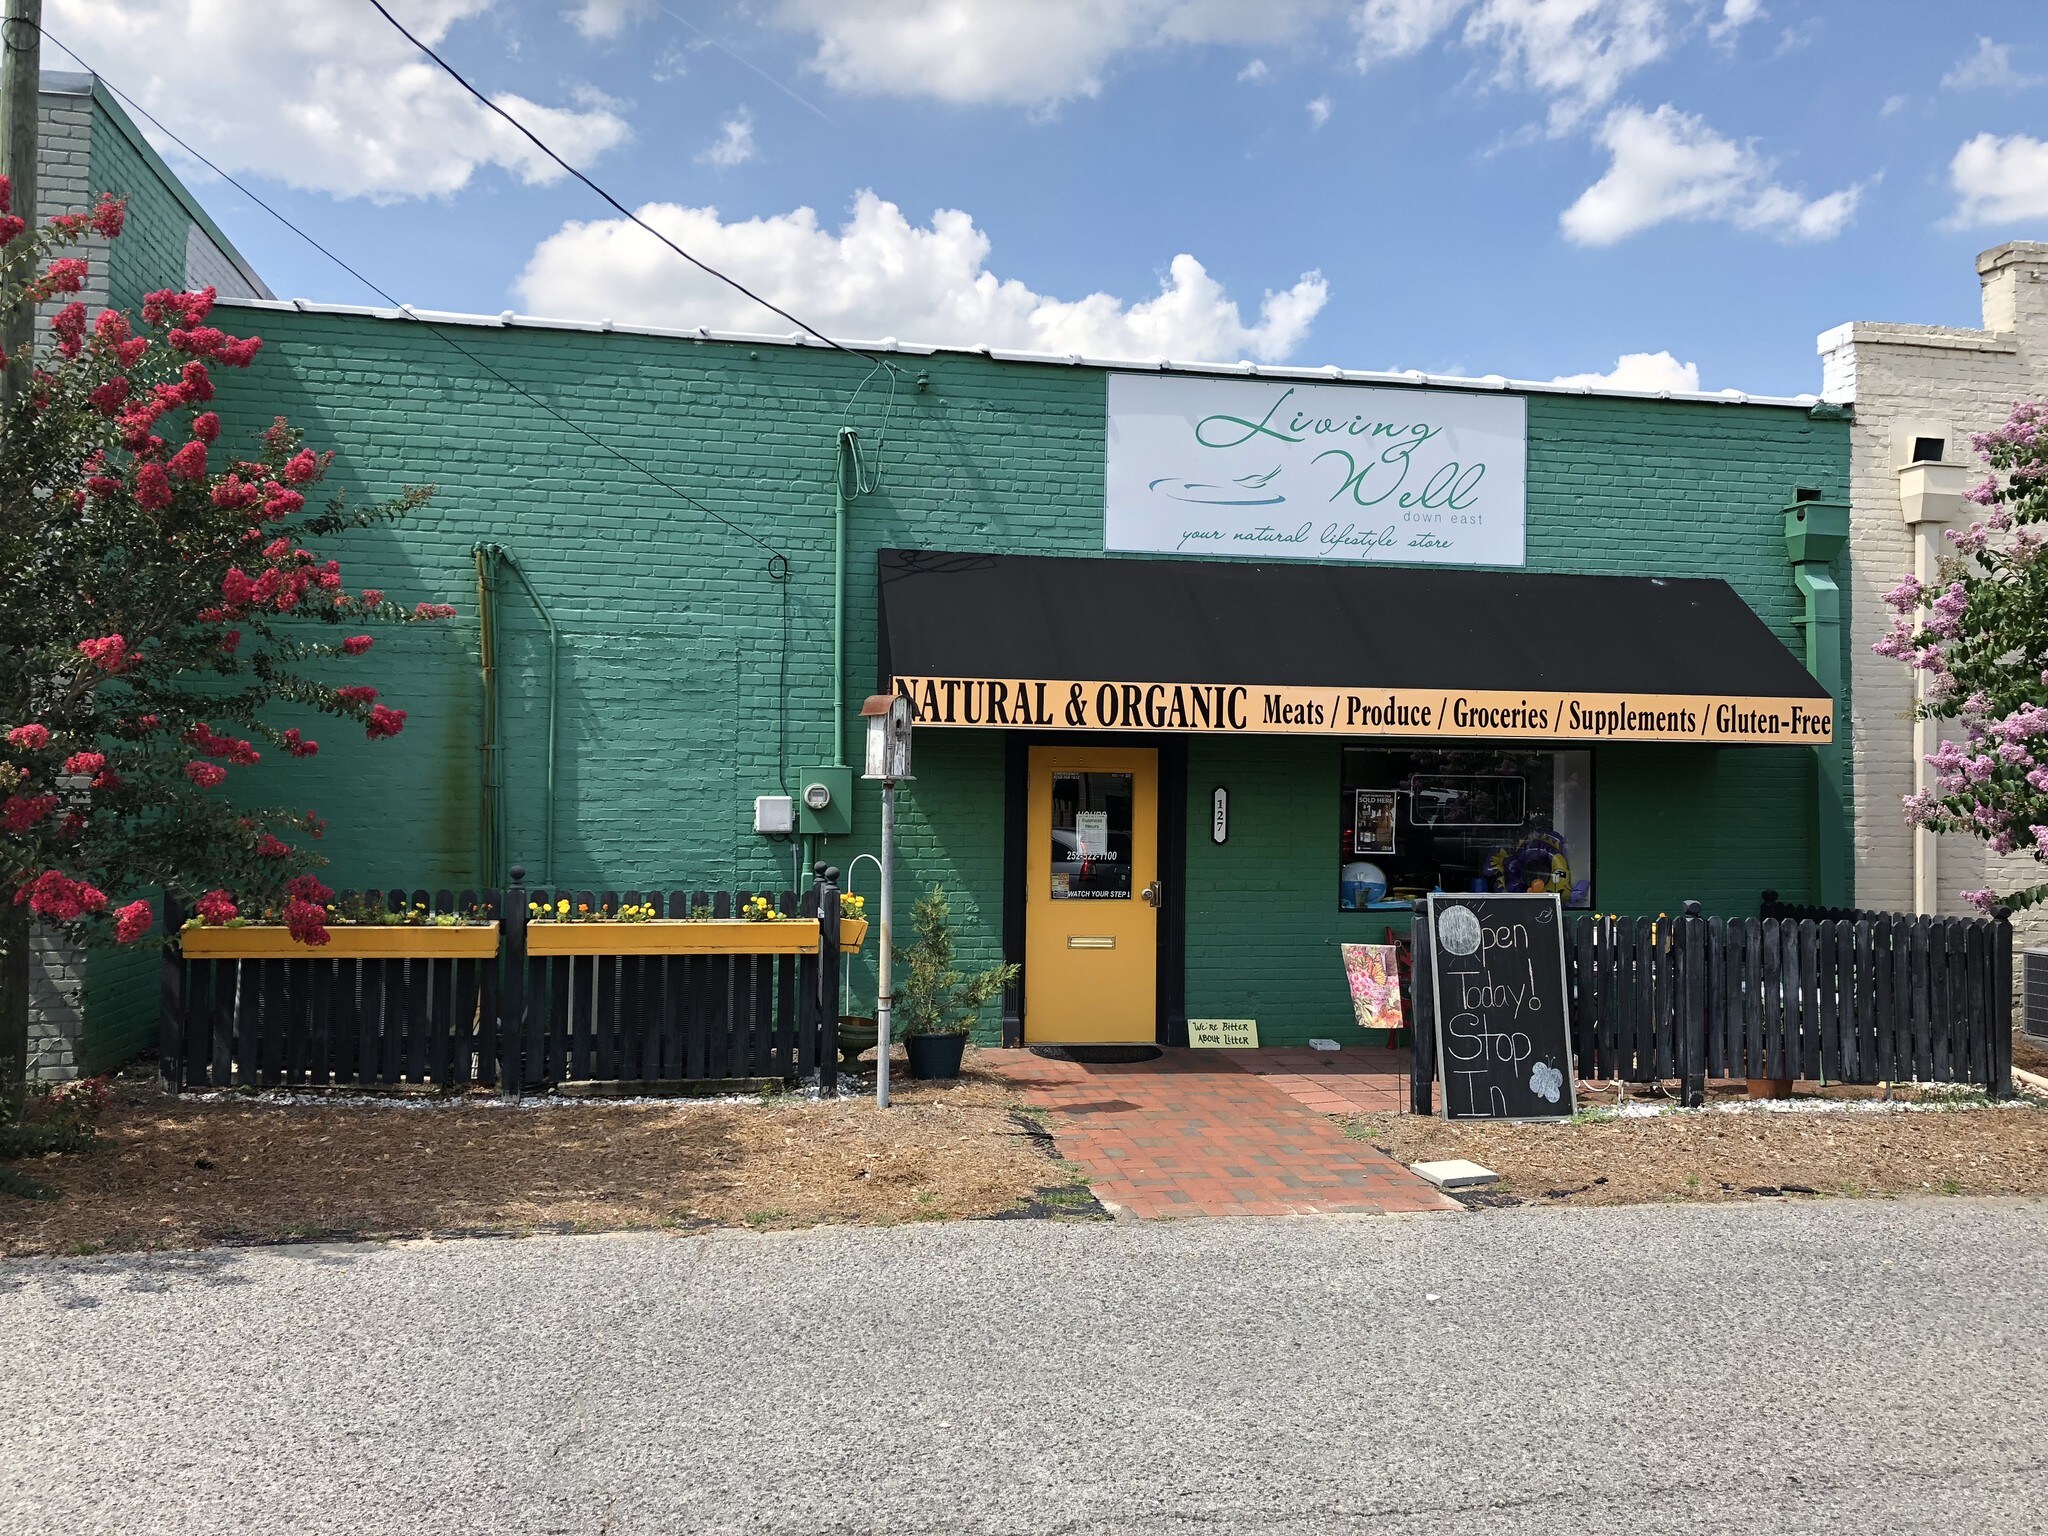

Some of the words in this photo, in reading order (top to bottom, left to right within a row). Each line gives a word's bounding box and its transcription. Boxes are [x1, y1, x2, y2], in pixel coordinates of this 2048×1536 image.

[1195, 387, 1443, 464] Living
[1310, 448, 1486, 511] Well
[1176, 529, 1226, 551] your
[1233, 521, 1310, 545] natural
[1318, 523, 1398, 558] lifestyle
[1407, 531, 1454, 549] store
[1403, 510, 1442, 524] down
[1450, 512, 1483, 525] east
[1064, 682, 1087, 727] &
[1096, 682, 1247, 729] ORGANIC
[1262, 694, 1324, 726] Meats
[1347, 696, 1432, 727] Produce
[1453, 698, 1549, 730] Groceries
[1569, 702, 1697, 735] Supplements
[1716, 704, 1832, 735] Gluten-Free
[1216, 799, 1225, 832] 127
[1067, 851, 1117, 861] 252-522-1100
[1068, 890, 1091, 898] WATCH
[1091, 890, 1110, 898] YOUR
[1447, 958, 1542, 1019] Today!
[1448, 1013, 1532, 1078] Stop
[1453, 1069, 1508, 1117] In
